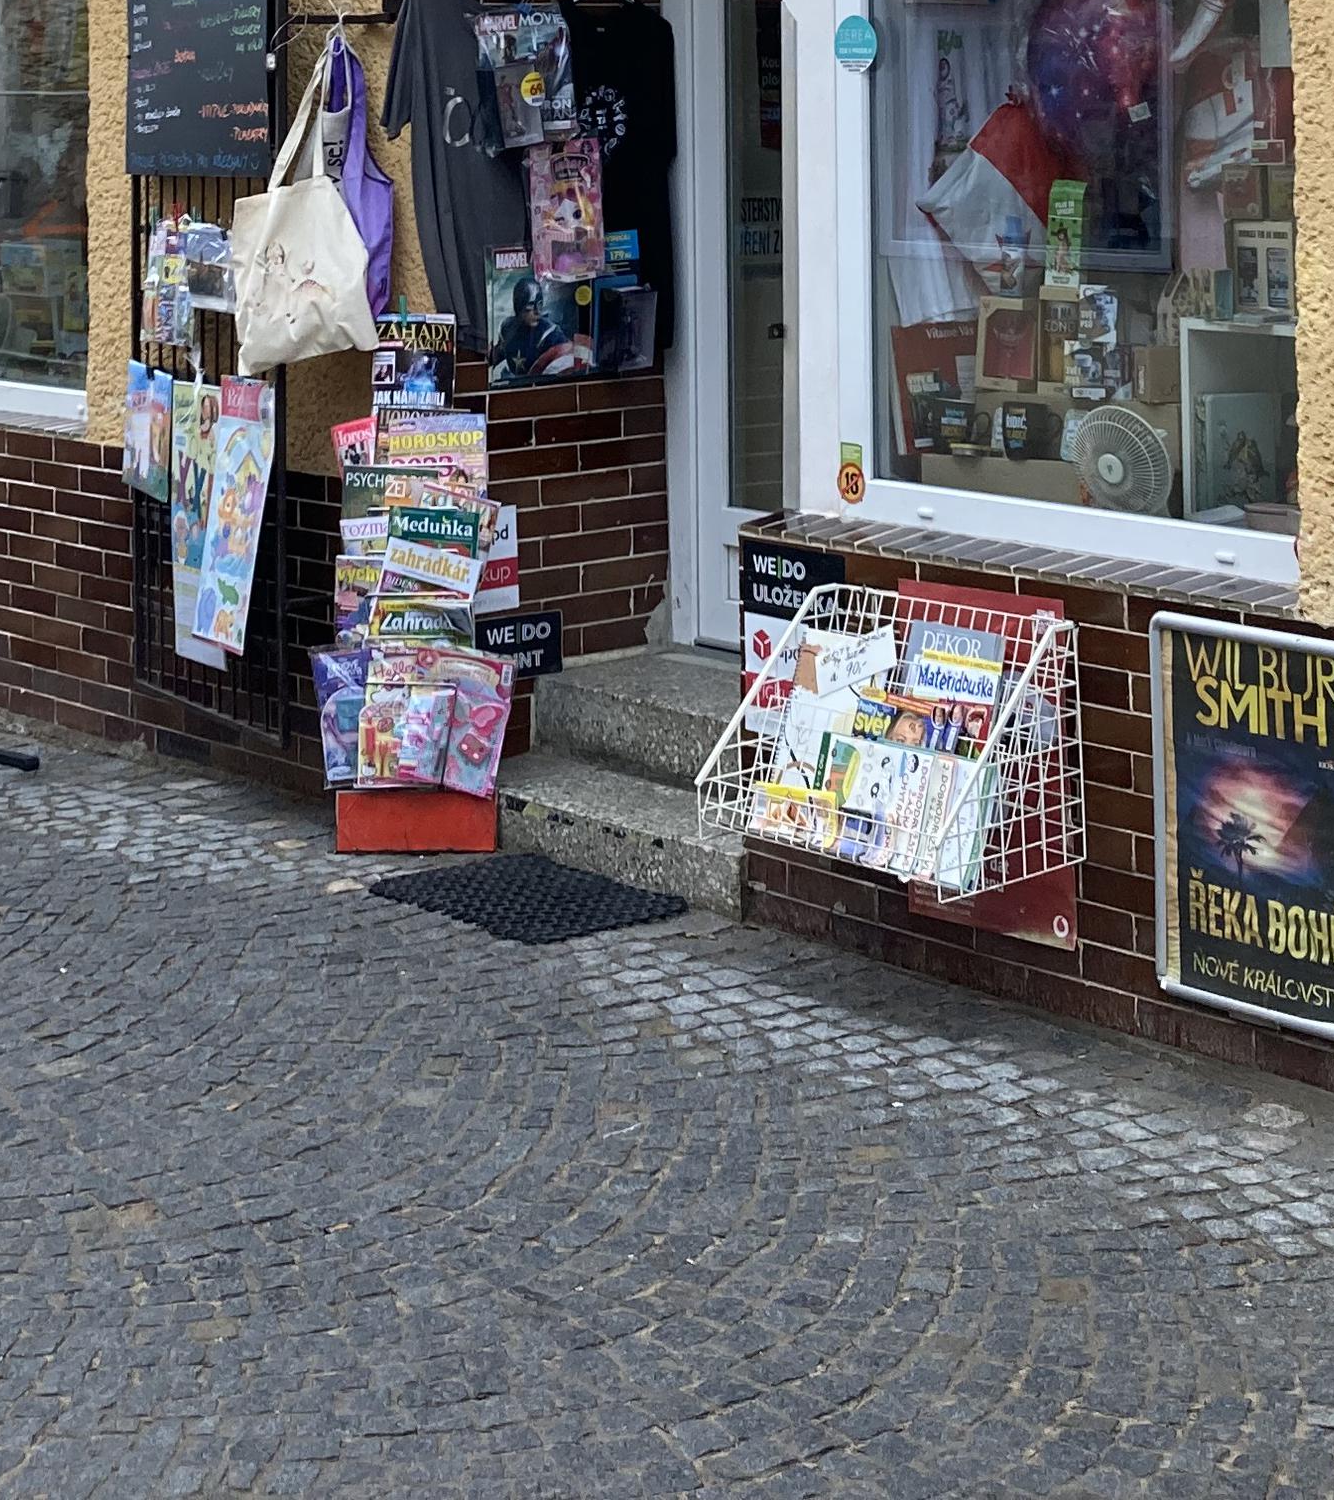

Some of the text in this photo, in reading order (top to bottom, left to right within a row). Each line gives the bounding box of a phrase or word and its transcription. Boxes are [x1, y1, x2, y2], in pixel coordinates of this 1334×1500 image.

[495, 251, 529, 269] MARVEL
[376, 318, 453, 341] ZÁHADY
[373, 390, 392, 406] JAK
[389, 430, 484, 450] HOROSKOP
[392, 514, 474, 538] Meduňka
[491, 523, 509, 546] pd
[514, 649, 545, 668] INT
[1195, 675, 1329, 748] SMITH
[1188, 867, 1264, 950] ŘEKA
[1191, 951, 1240, 985] NOVÉ
